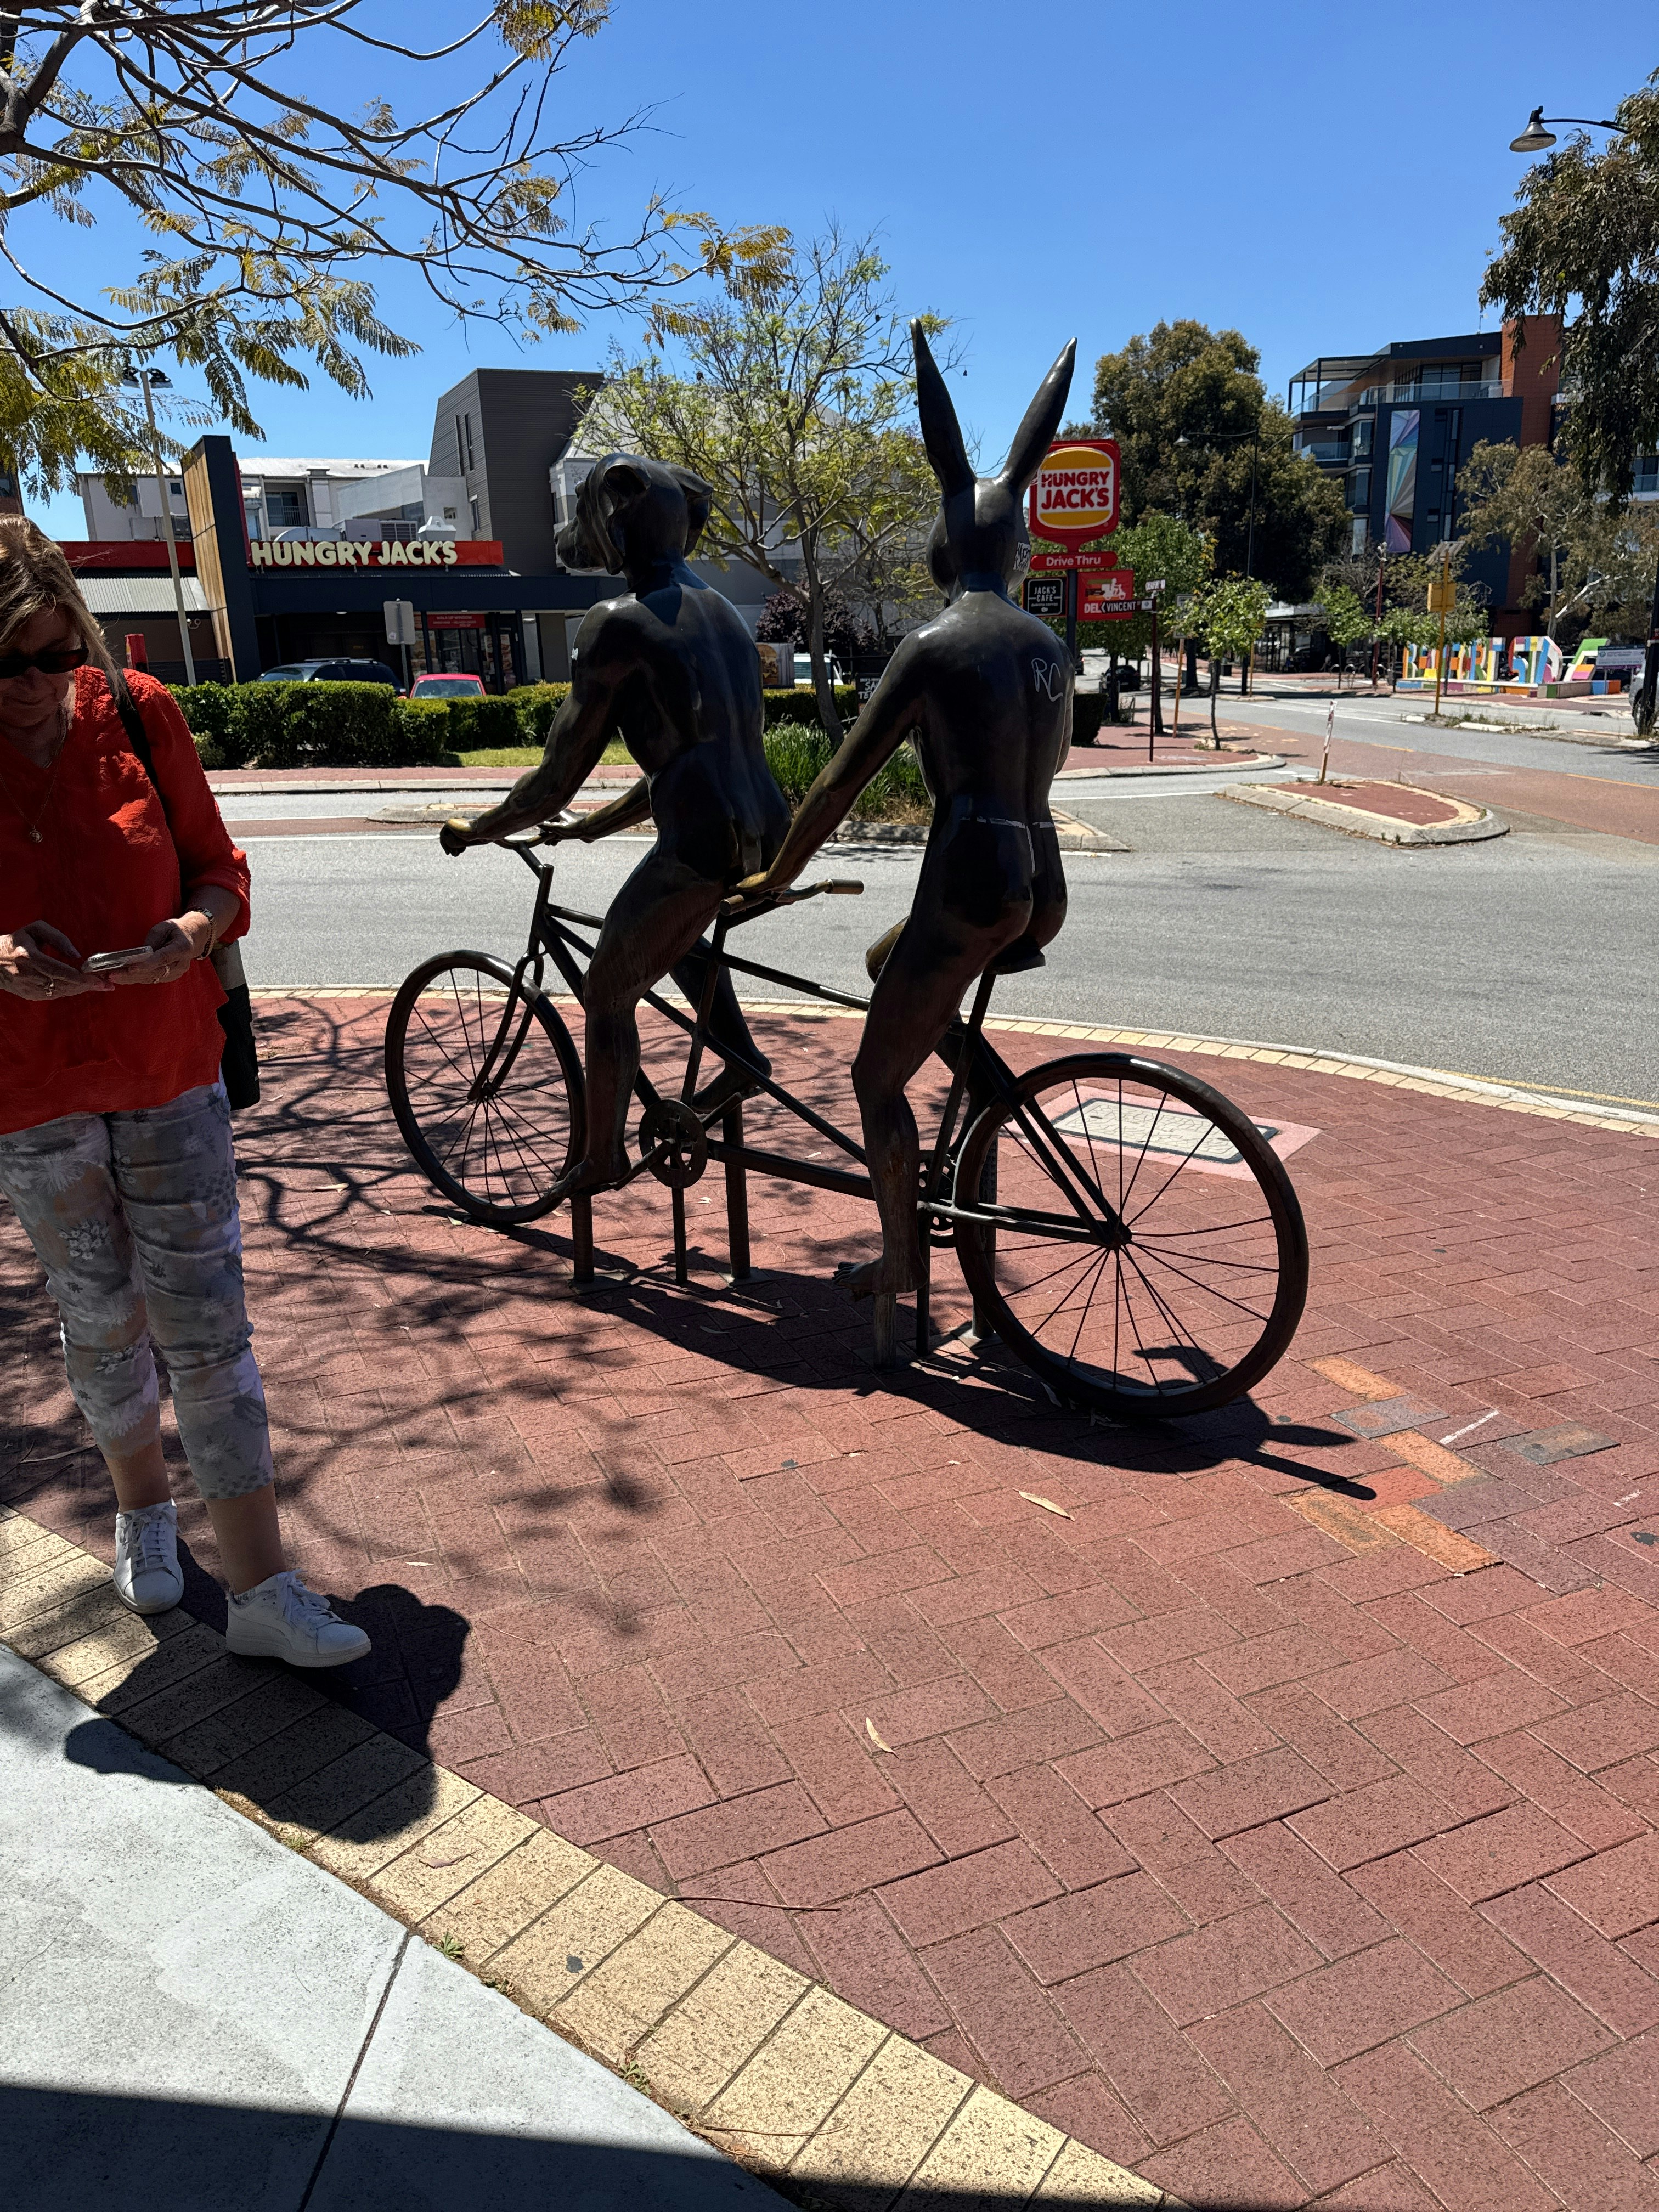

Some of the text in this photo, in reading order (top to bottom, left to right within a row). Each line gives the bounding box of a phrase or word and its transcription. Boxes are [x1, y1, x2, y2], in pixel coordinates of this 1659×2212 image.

[1041, 471, 1110, 487] HUNGRY
[1041, 488, 1109, 510] JACK'S
[250, 541, 458, 566] HUNGRY JACK'S
[1046, 555, 1101, 567] Drive Thru
[1034, 585, 1057, 595] JACK'S
[1036, 594, 1053, 602] CAFE
[1084, 603, 1102, 614] DEL
[1106, 601, 1137, 612] VINCENT
